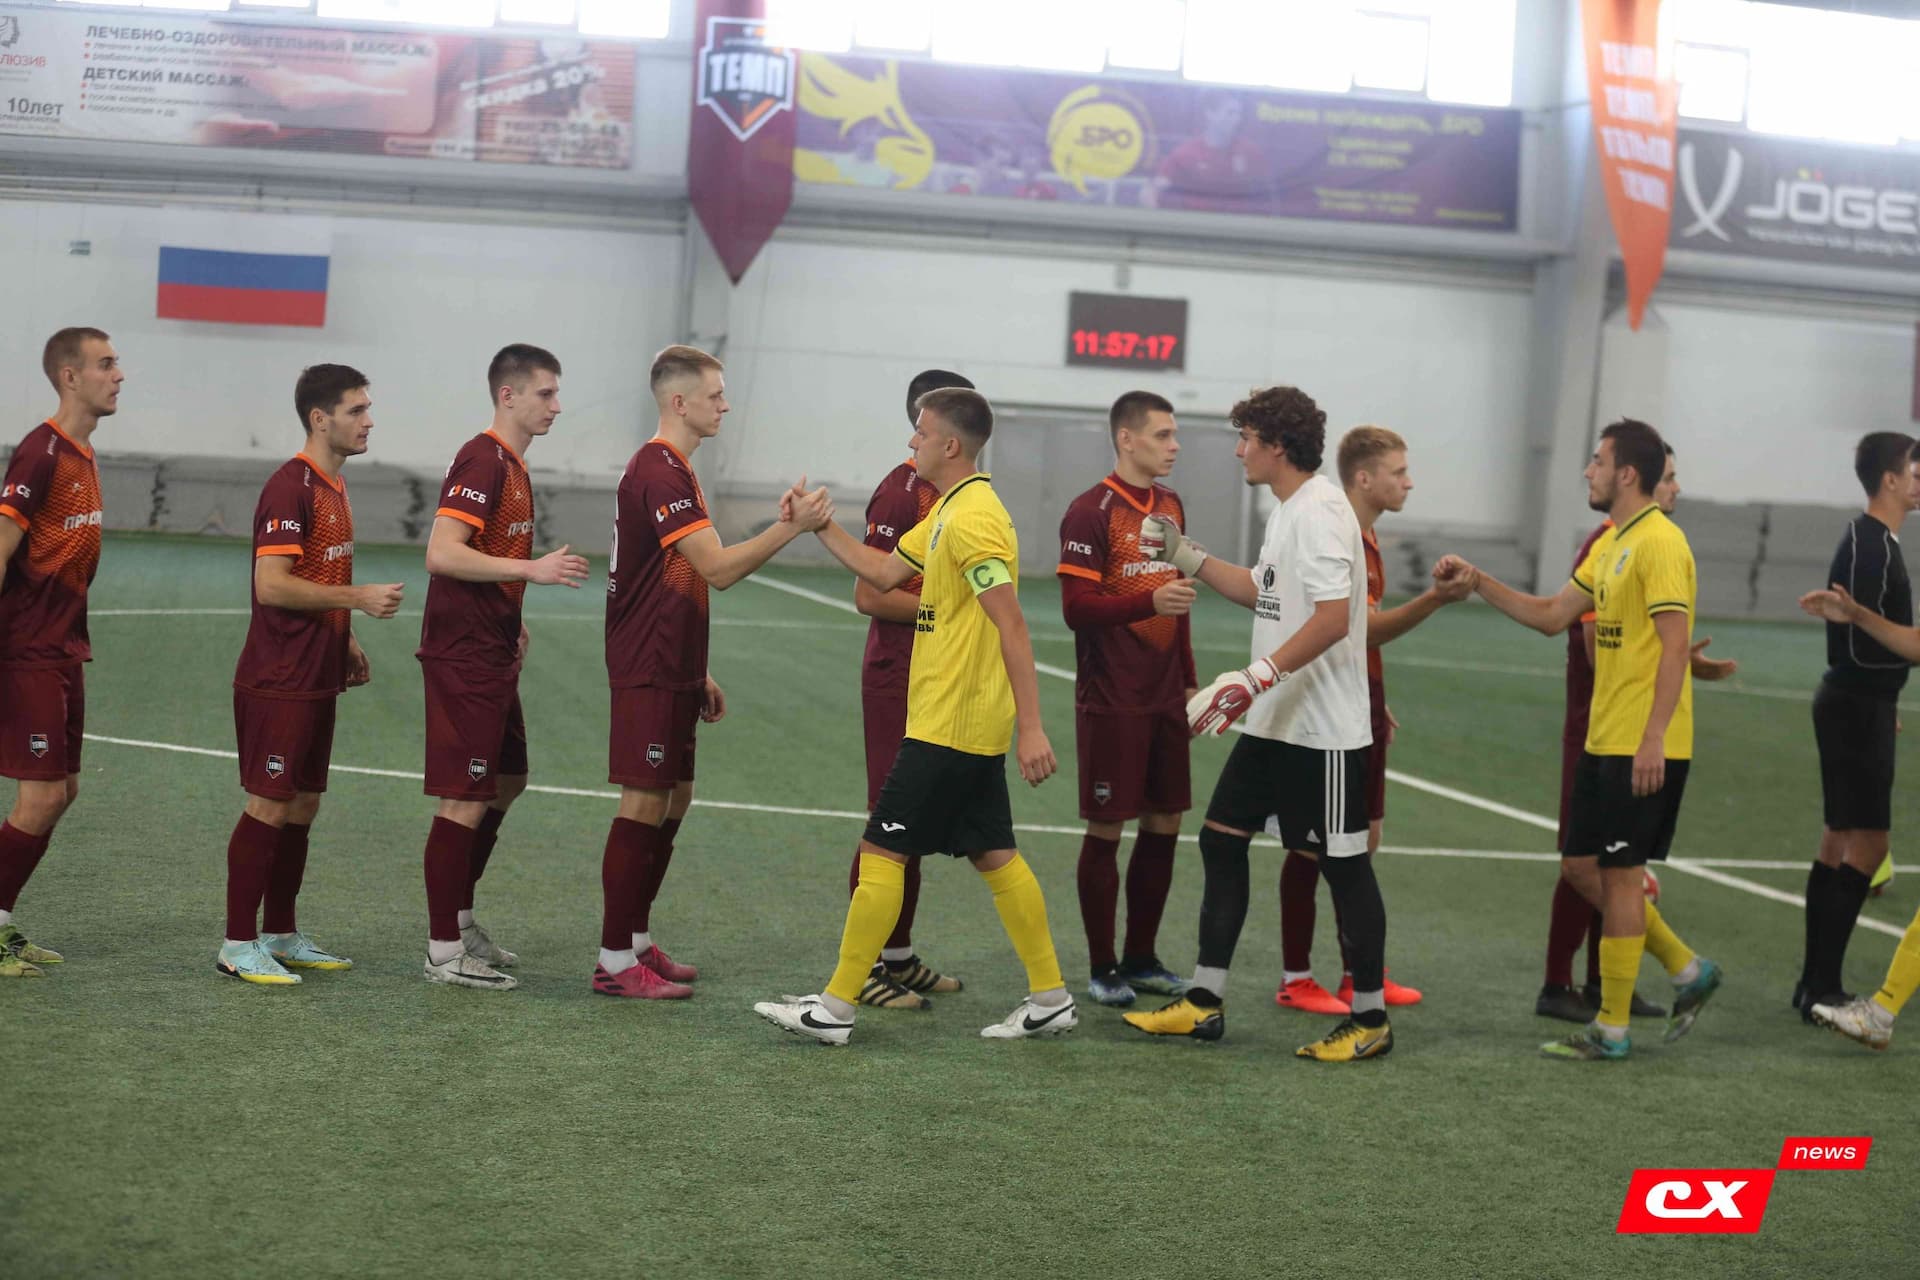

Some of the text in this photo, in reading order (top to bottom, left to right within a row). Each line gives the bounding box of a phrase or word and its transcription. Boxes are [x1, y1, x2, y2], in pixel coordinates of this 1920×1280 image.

[83, 66, 163, 82] ДЕТСКИЙ
[1744, 167, 1920, 234] JÖGE
[1072, 329, 1177, 360] 11:57:17
[461, 487, 487, 504] ПСБ
[669, 498, 692, 514] ПСБ
[281, 519, 301, 533] ПСБ
[1067, 541, 1092, 555] ПСБ
[973, 565, 994, 589] C
